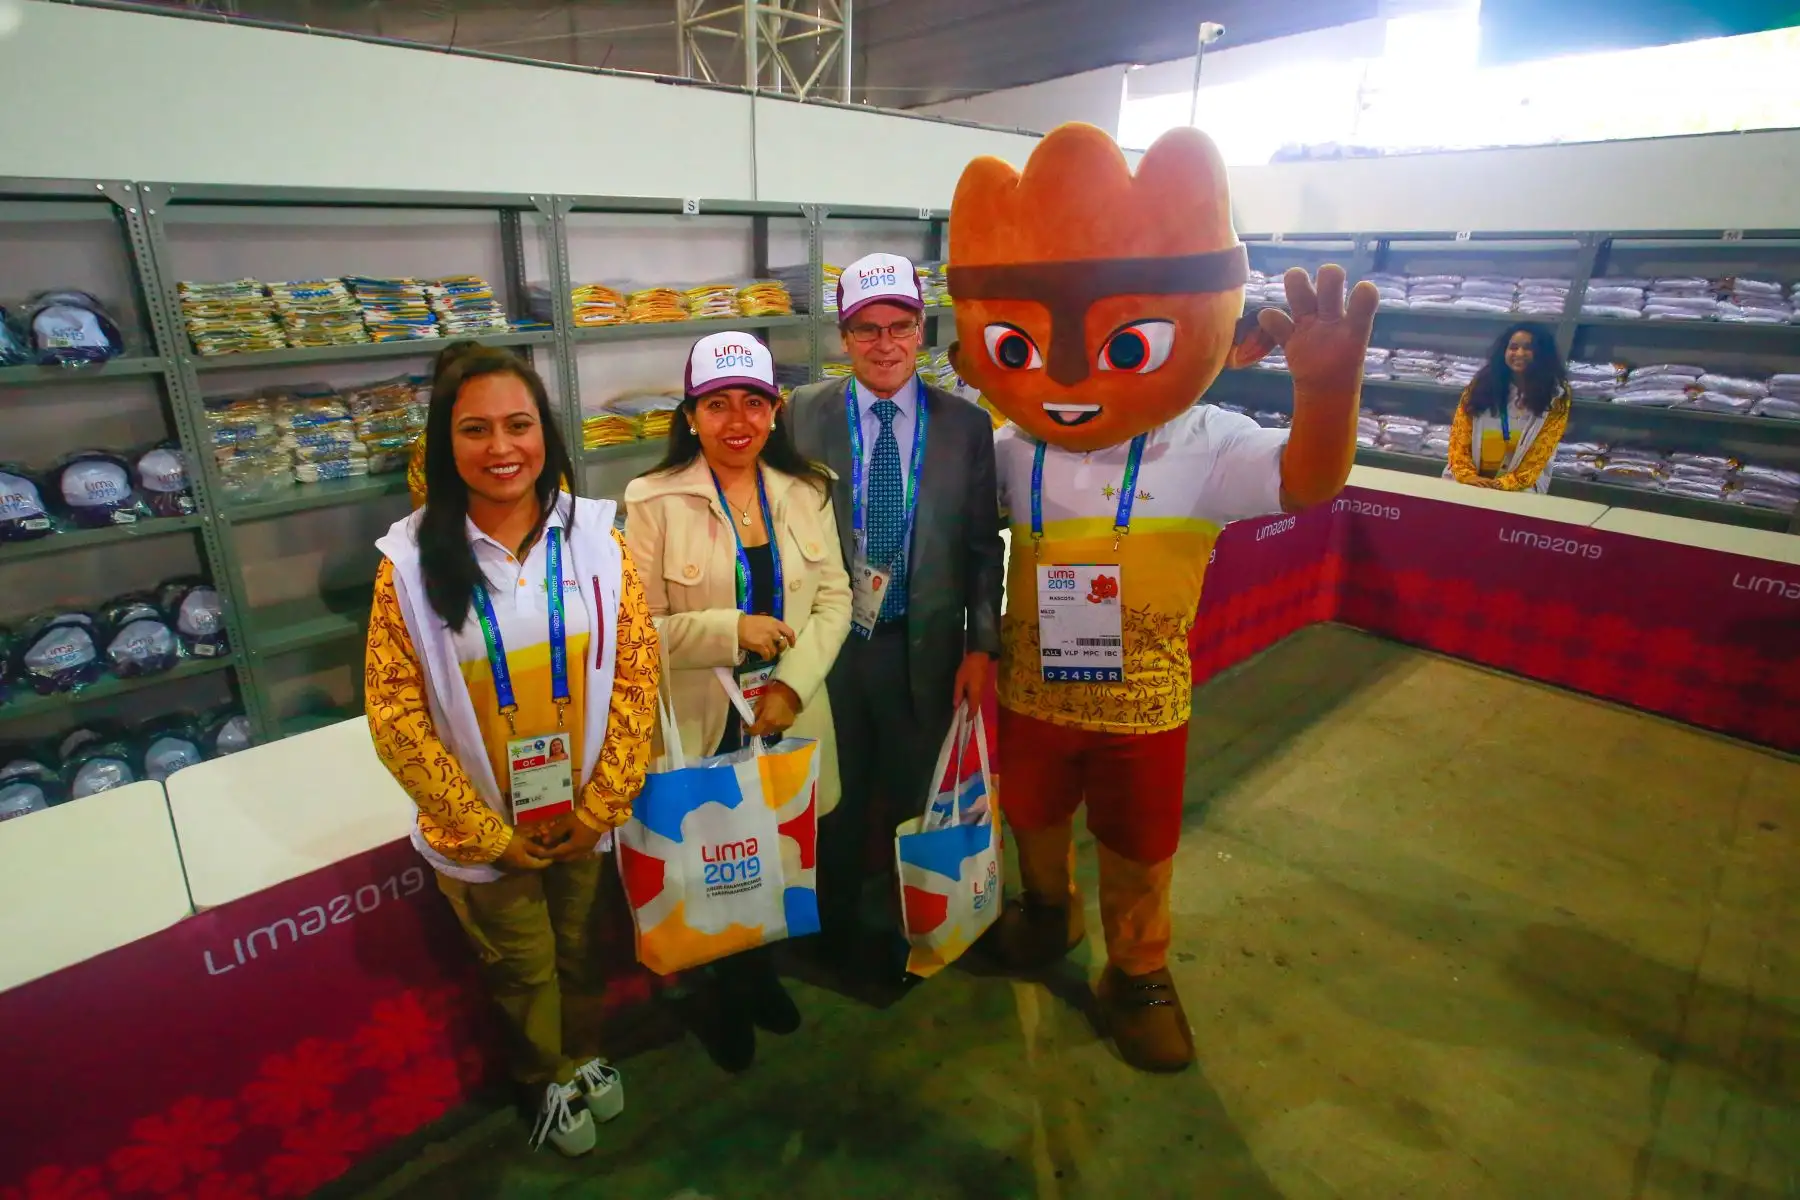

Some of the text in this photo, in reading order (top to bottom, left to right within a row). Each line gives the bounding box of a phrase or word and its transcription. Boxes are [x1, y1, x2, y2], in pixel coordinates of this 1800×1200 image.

[688, 200, 695, 211] S
[860, 274, 896, 290] 2019
[714, 344, 752, 357] Lima
[715, 355, 754, 369] 2019
[1331, 499, 1401, 521] ima2019
[1256, 515, 1297, 542] Lima2019
[1499, 528, 1603, 560] Lima2019
[1047, 570, 1075, 579] Lima
[1048, 580, 1075, 589] 2019
[522, 758, 536, 767] OC
[702, 837, 758, 862] Lima
[704, 856, 760, 884] 2019
[203, 866, 425, 975] Lima2019
